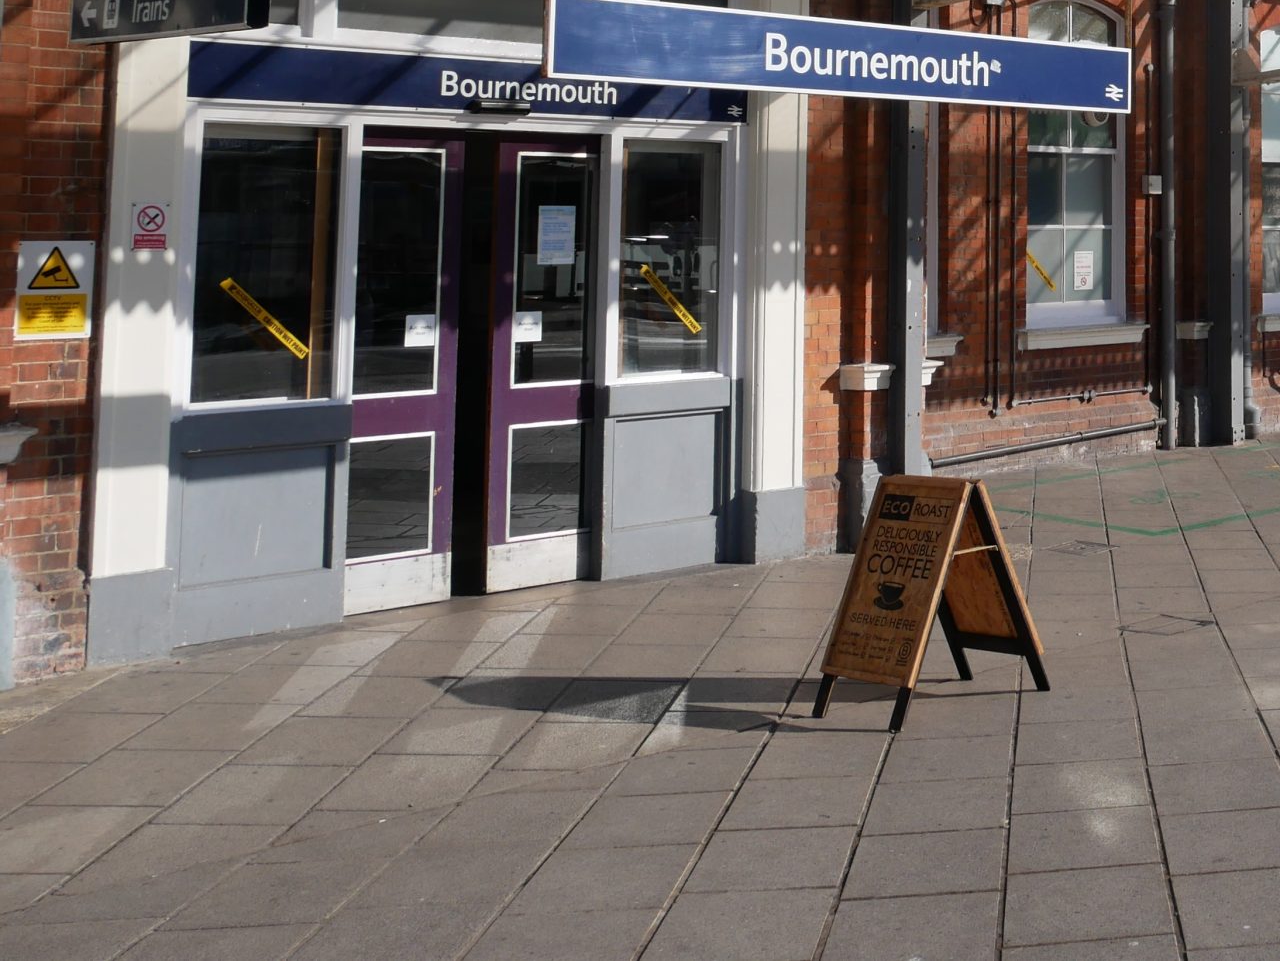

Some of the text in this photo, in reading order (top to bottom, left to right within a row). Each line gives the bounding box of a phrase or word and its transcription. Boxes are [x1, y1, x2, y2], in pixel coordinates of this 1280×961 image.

[765, 32, 990, 88] Bournemouth
[440, 70, 618, 106] Bournemouth
[263, 315, 285, 337] CAUTION
[291, 341, 307, 357] PAINT
[882, 500, 951, 518] ECO ROAST
[876, 525, 942, 543] DELICIOUSLY
[872, 539, 938, 557] RESPONSIBLE
[867, 553, 933, 579] COFFEE
[849, 612, 916, 631] SERVED HERE
